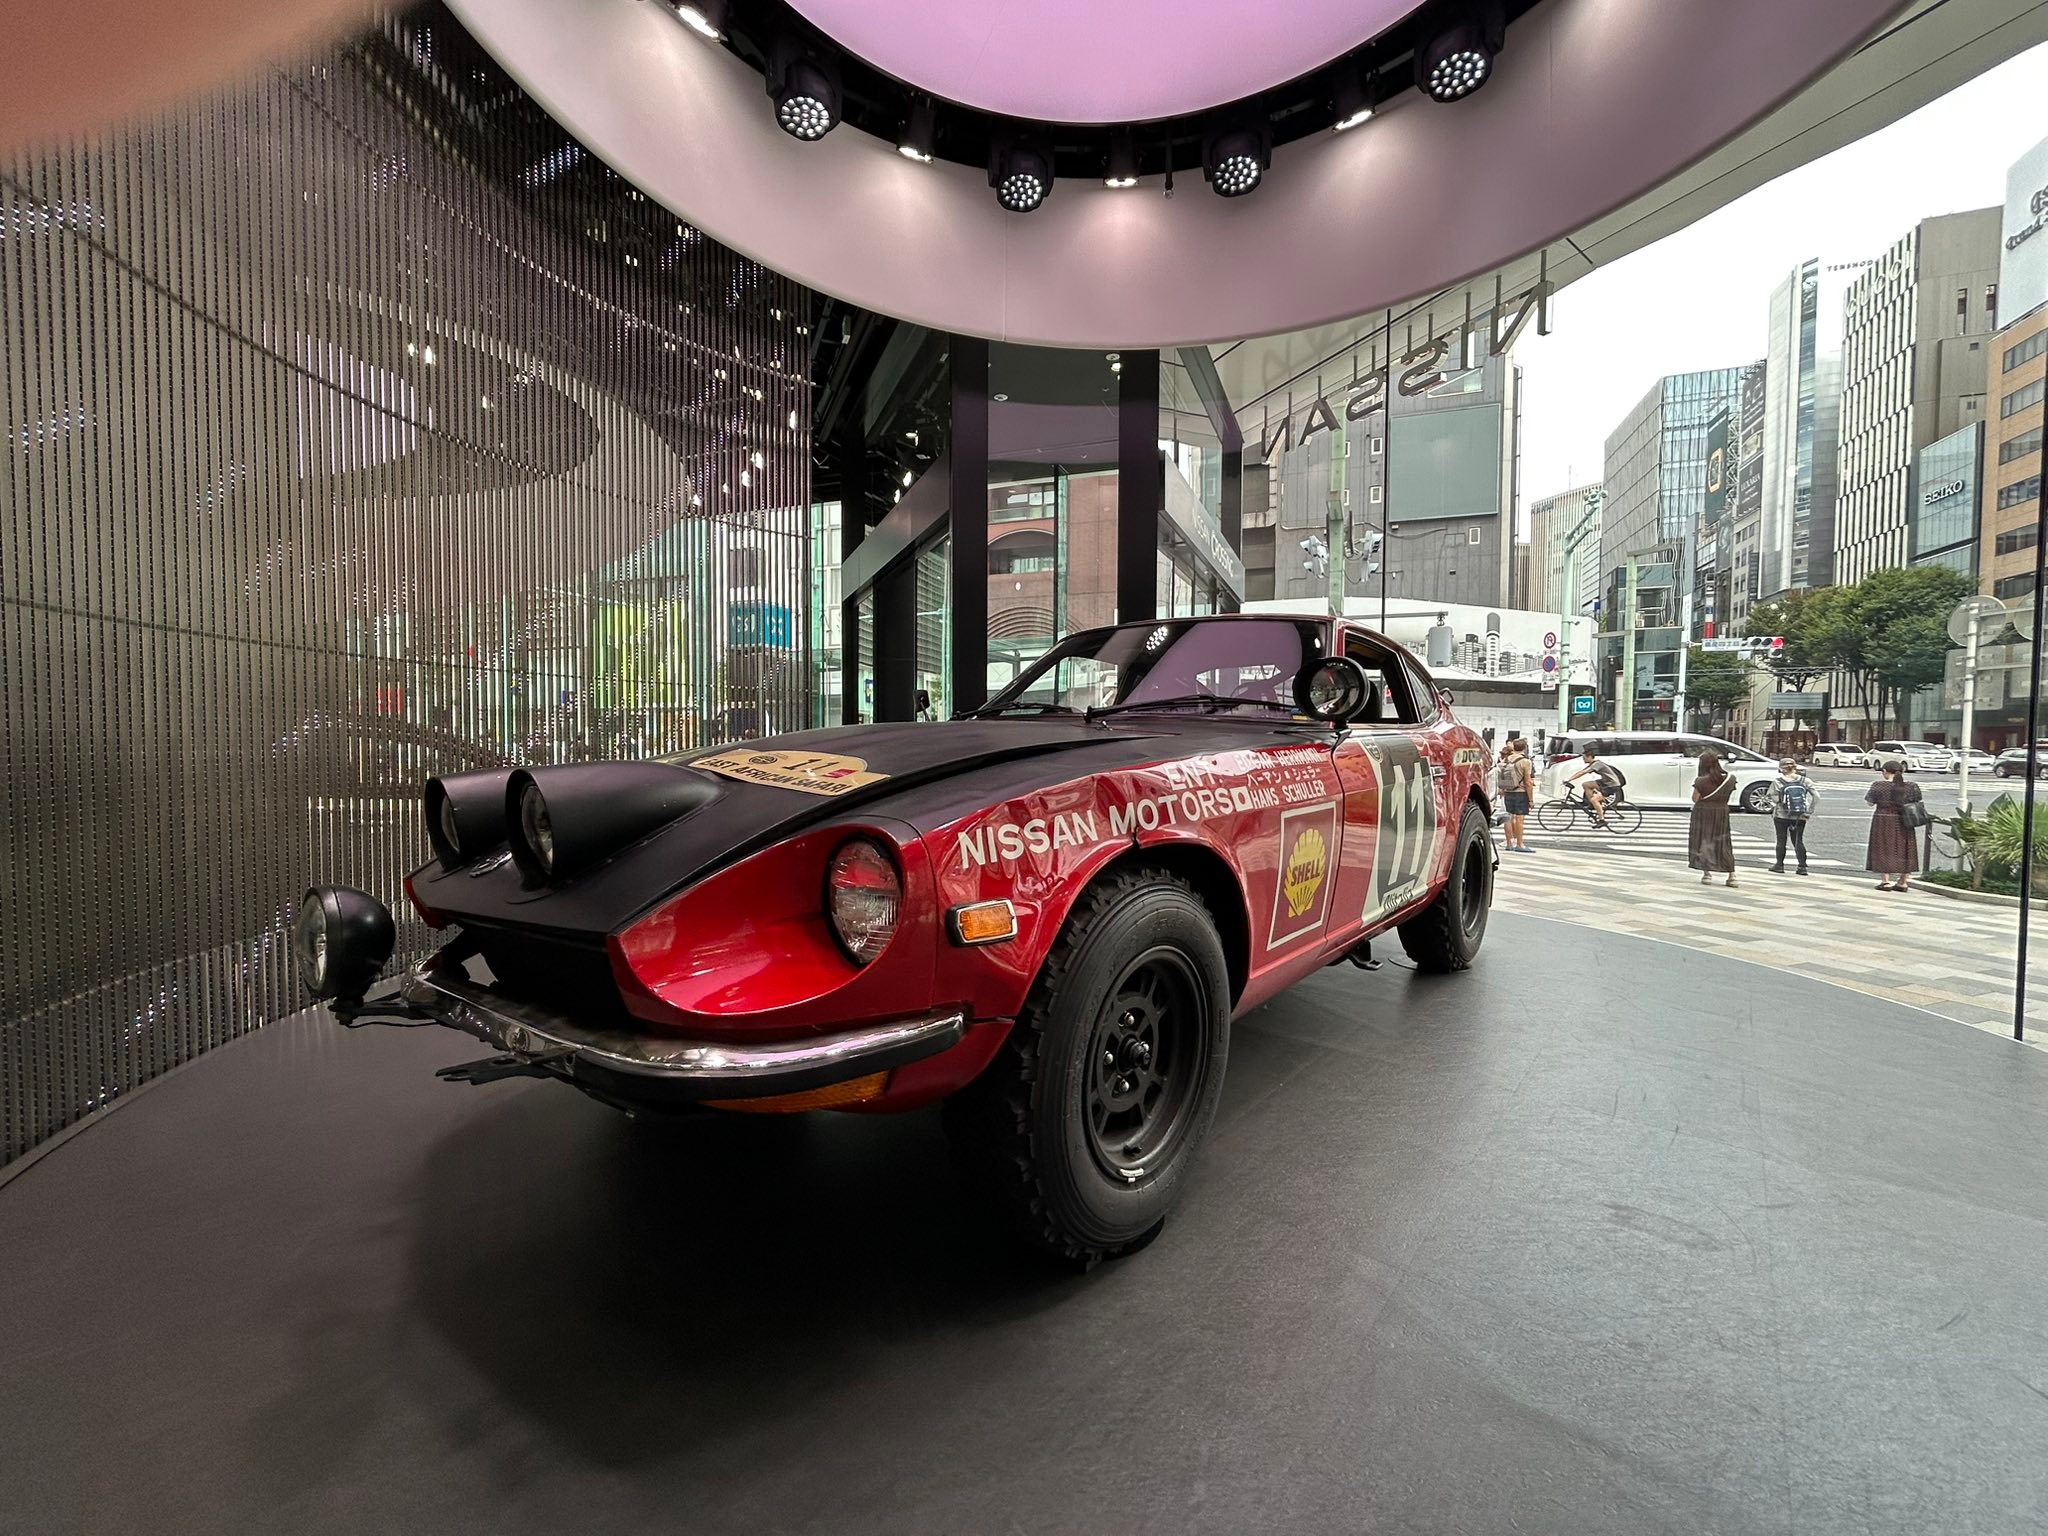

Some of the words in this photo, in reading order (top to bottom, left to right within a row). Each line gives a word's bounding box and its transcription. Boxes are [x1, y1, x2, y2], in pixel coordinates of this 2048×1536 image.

[1923, 480, 1964, 506] SEIKO
[698, 758, 740, 769] EAST
[729, 766, 799, 784] AFRICAN
[790, 779, 853, 793] SAFARI
[1249, 787, 1281, 810] HANS
[1281, 779, 1327, 803] SCHULLER
[958, 809, 1099, 870] NISSAN
[1108, 787, 1234, 837] MOTORS
[1387, 761, 1425, 886] 11
[1290, 857, 1321, 887] SHELL
